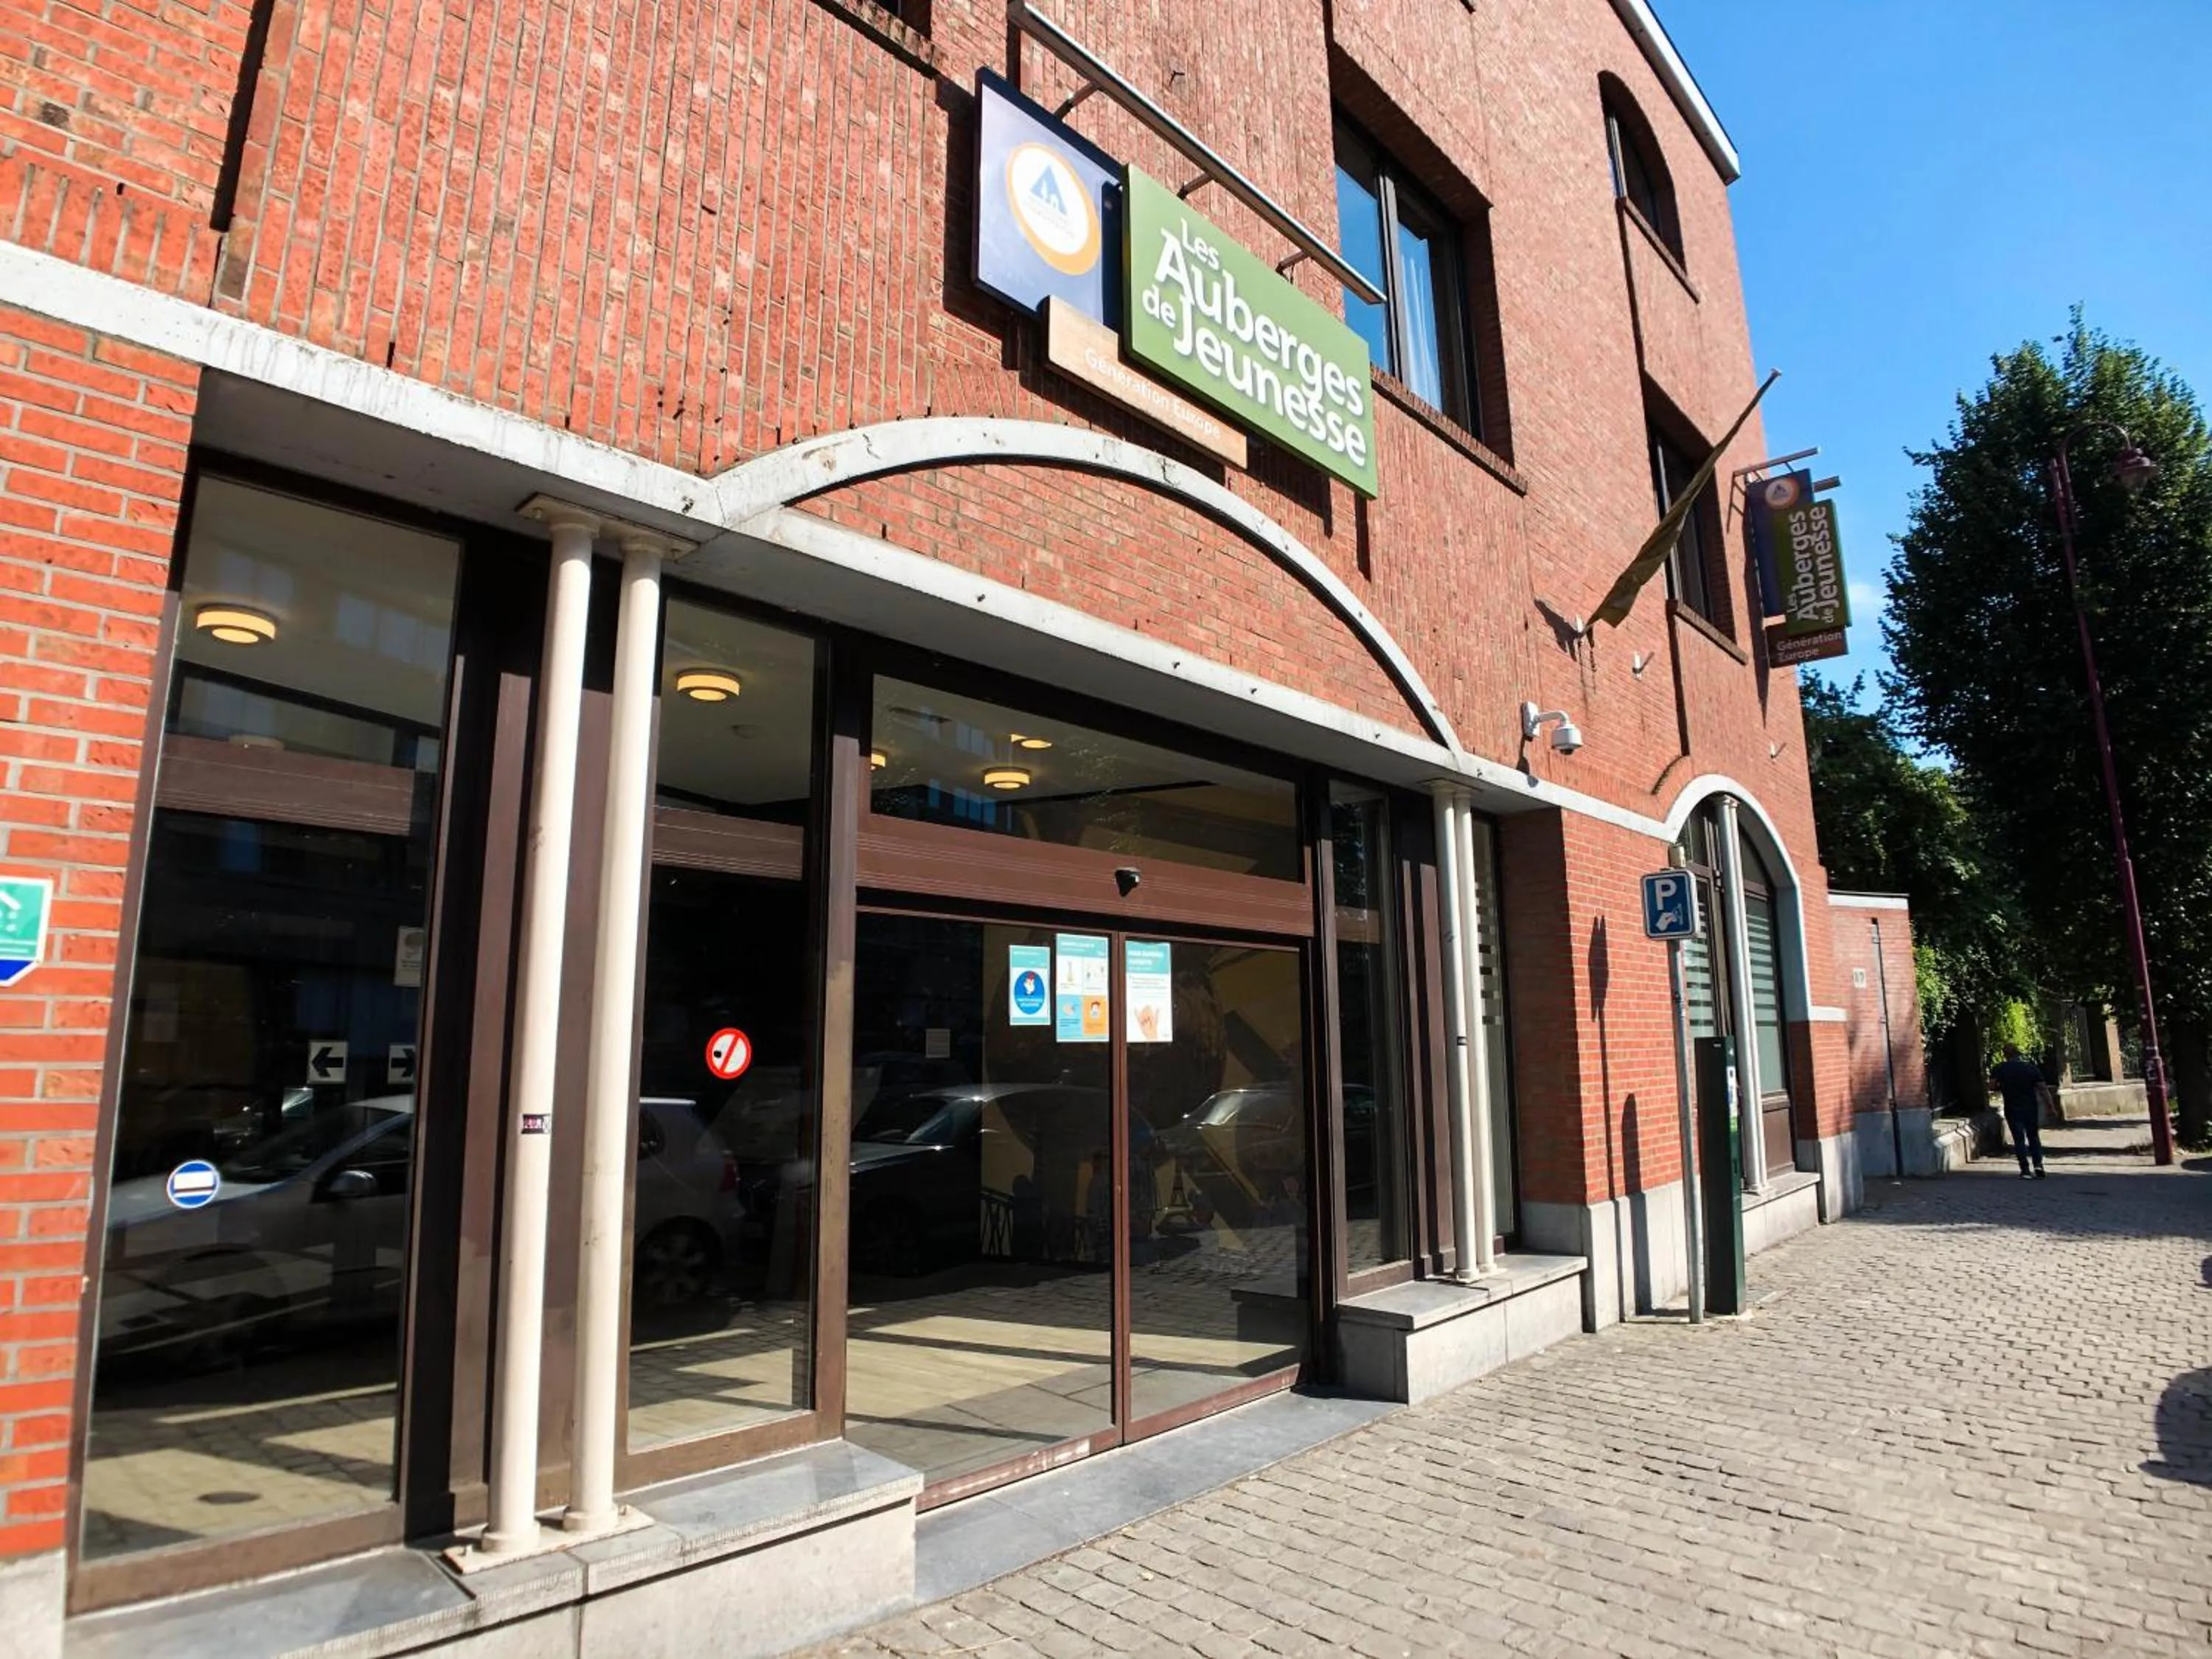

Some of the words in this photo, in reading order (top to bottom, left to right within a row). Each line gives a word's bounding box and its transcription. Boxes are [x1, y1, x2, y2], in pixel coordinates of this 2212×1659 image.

[1180, 217, 1219, 269] Les
[1155, 229, 1364, 417] Auberges
[1142, 287, 1176, 328] de
[1174, 295, 1366, 467] Jeunesse
[1172, 397, 1221, 439] Europe
[1790, 511, 1819, 620] Auberges
[1809, 507, 1840, 608] Jeunesse
[1655, 878, 1677, 911] P
